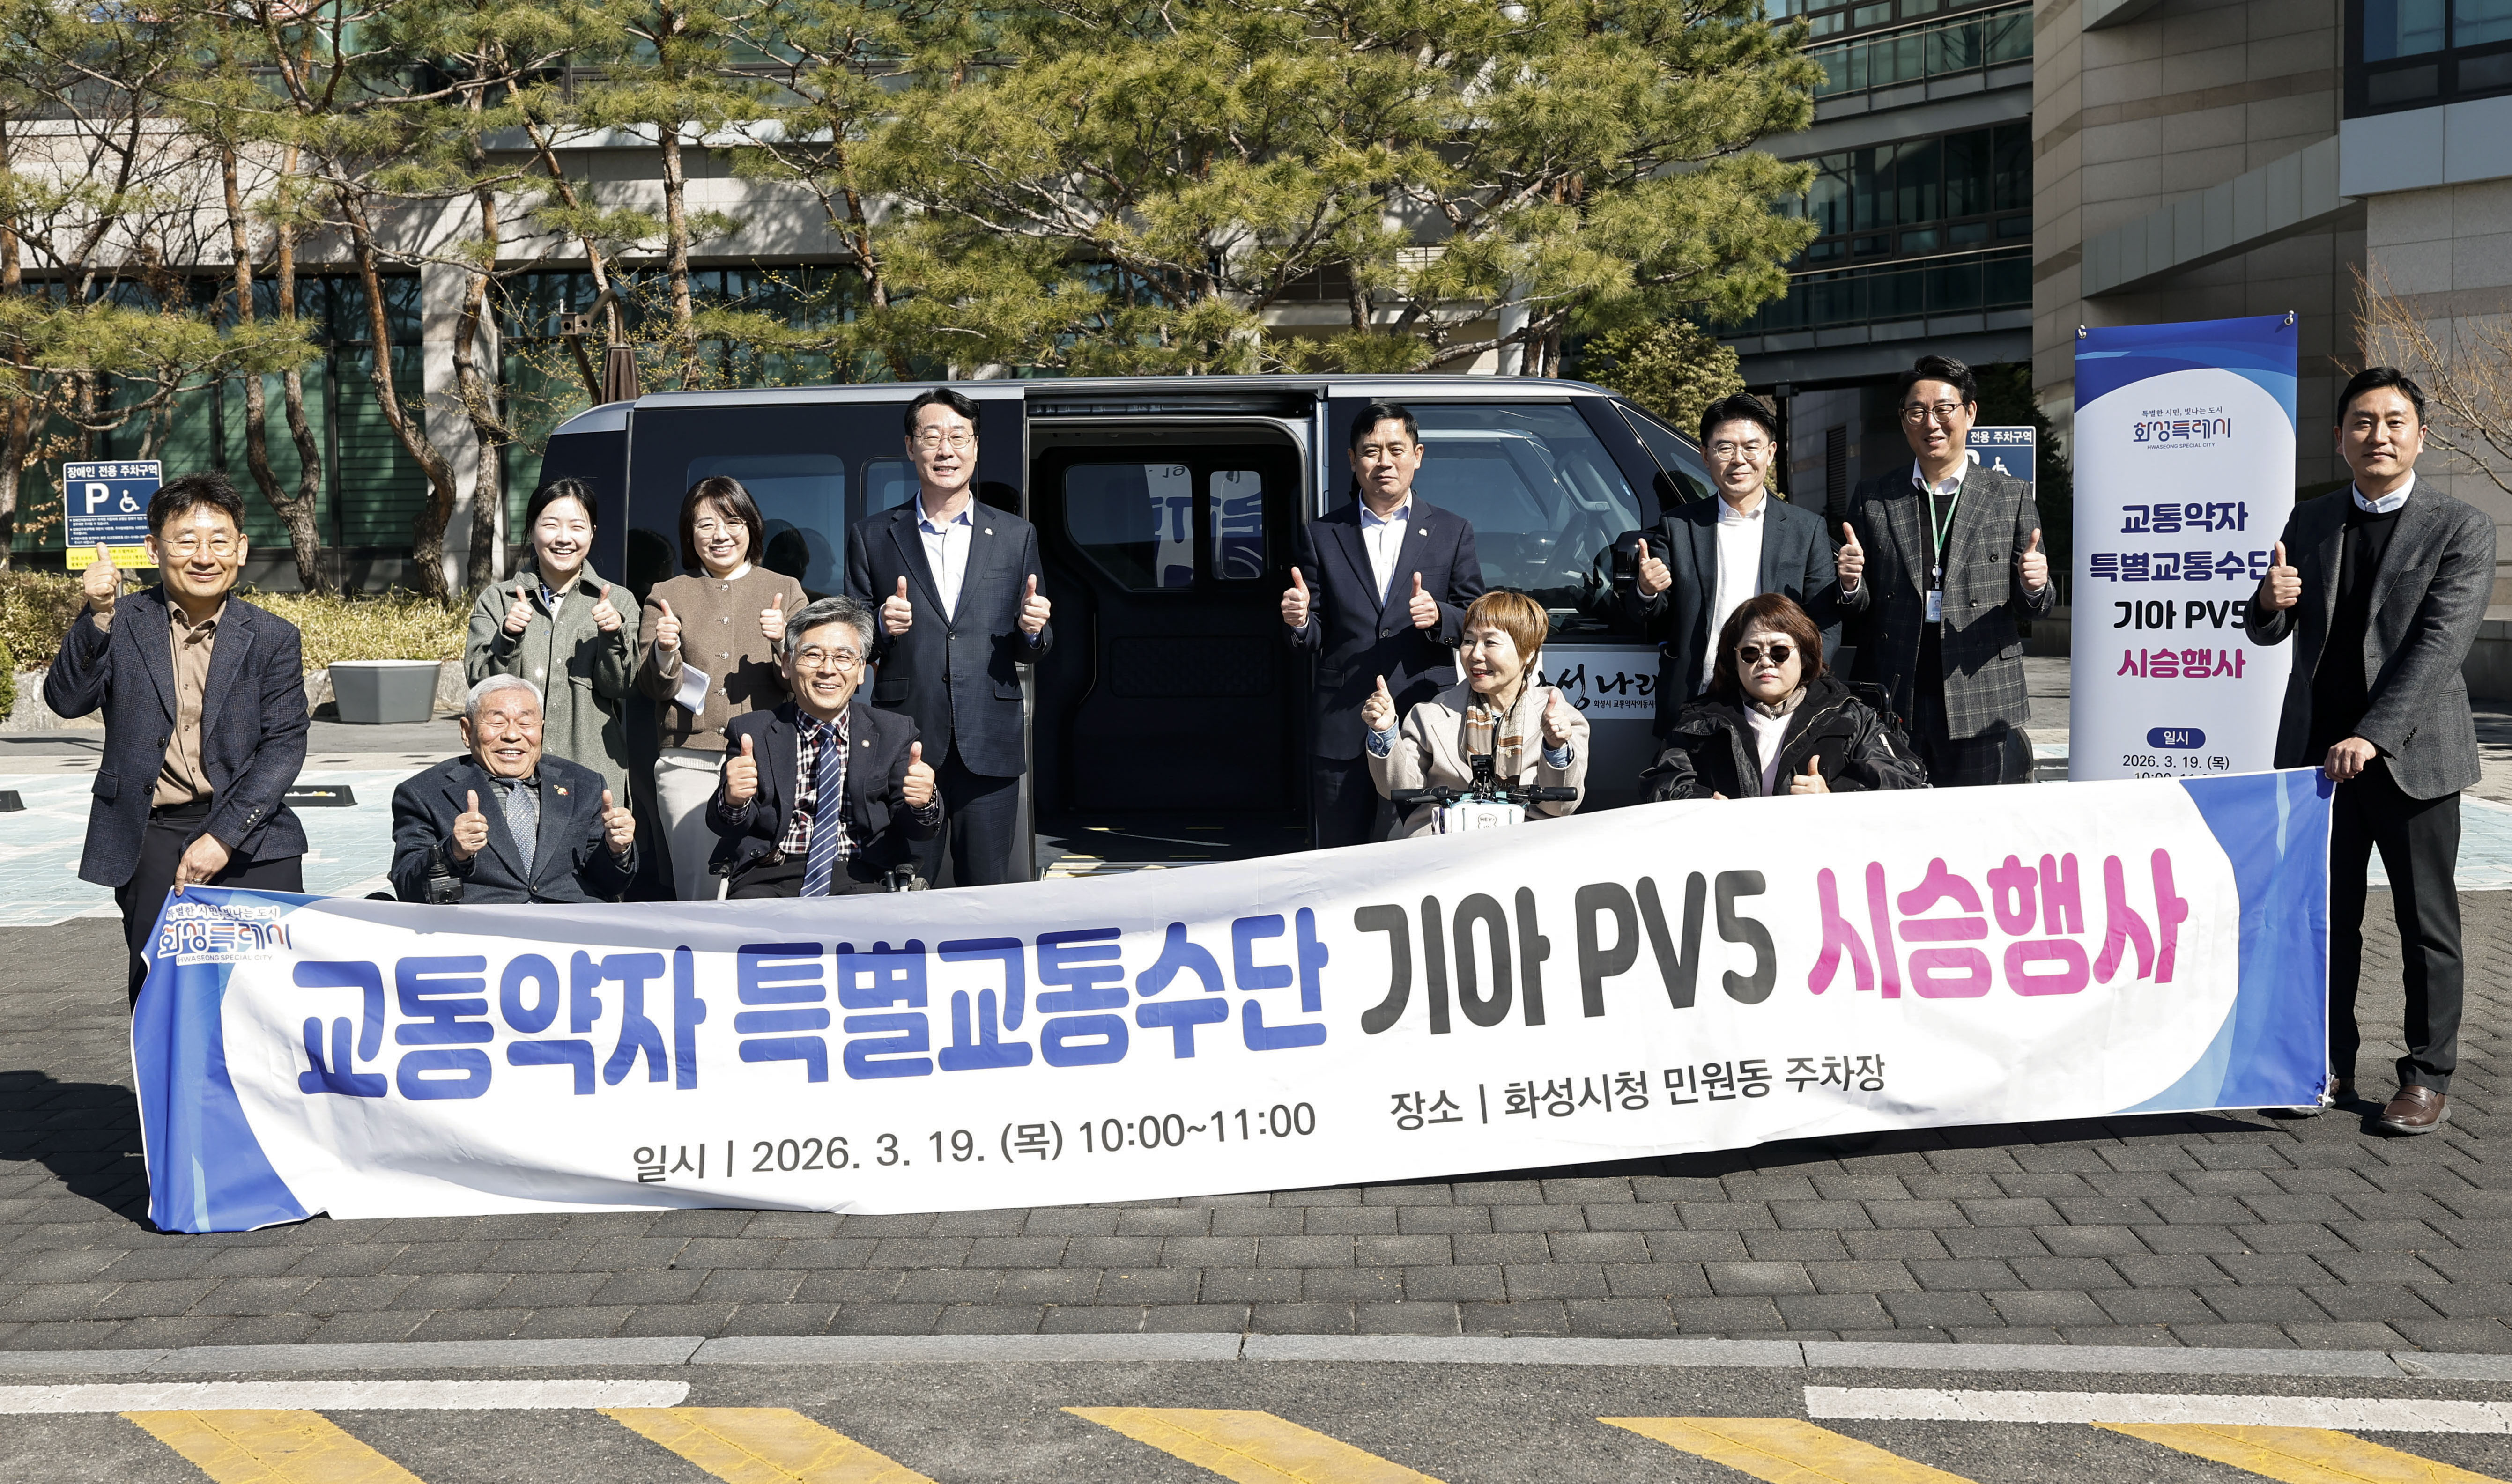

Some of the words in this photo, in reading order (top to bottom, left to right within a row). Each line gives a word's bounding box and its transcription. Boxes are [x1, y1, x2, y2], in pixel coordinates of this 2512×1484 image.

[2142, 409, 2164, 418] 특별한
[2165, 408, 2182, 416] 시민,
[2185, 407, 2206, 416] 빛나는
[1970, 431, 1990, 443] 전용
[1993, 431, 2032, 443] 주차구역
[2133, 418, 2231, 442] 화성특례시
[67, 466, 95, 479] 장애인
[98, 465, 117, 477] 전용
[120, 464, 158, 477] 주차구역
[85, 483, 110, 514] P
[2120, 501, 2249, 533] 교통약자
[2090, 551, 2275, 582] 특별교통수단
[2113, 600, 2177, 630] 기아
[2117, 648, 2246, 679] 시승행사
[1593, 700, 1611, 709] 화성시
[1613, 699, 1657, 709] 교통약자이동지
[2163, 731, 2189, 745] 일시
[2123, 754, 2159, 768] 2026.
[2164, 755, 2176, 768] 3.
[2182, 756, 2202, 768] 19.
[2207, 755, 2230, 770] (목)
[166, 906, 194, 918] 특별한
[199, 906, 222, 917] 시민,
[223, 907, 252, 918] 빛나는
[258, 908, 277, 917] 도시
[159, 922, 292, 956] 화성특례시
[178, 954, 220, 963] HWASEONG
[293, 945, 707, 1101] 교통약자
[734, 907, 1329, 1083] 특별교통수단
[1354, 886, 1551, 1035] 기아
[1575, 870, 1777, 1018] PV5
[1808, 848, 2189, 999] 시승행사
[633, 1143, 705, 1183] 일시
[752, 1136, 860, 1173] 2026.
[875, 1132, 910, 1167] 3.
[928, 1129, 985, 1163] 19.
[1000, 1120, 1063, 1164] (목)
[1079, 1101, 1316, 1153] 10:00~11:00
[1390, 1089, 1464, 1131] 장소
[1504, 1070, 1648, 1119] 화성시청
[1664, 1059, 1773, 1105] 민원동
[1785, 1053, 1886, 1093] 주차장
